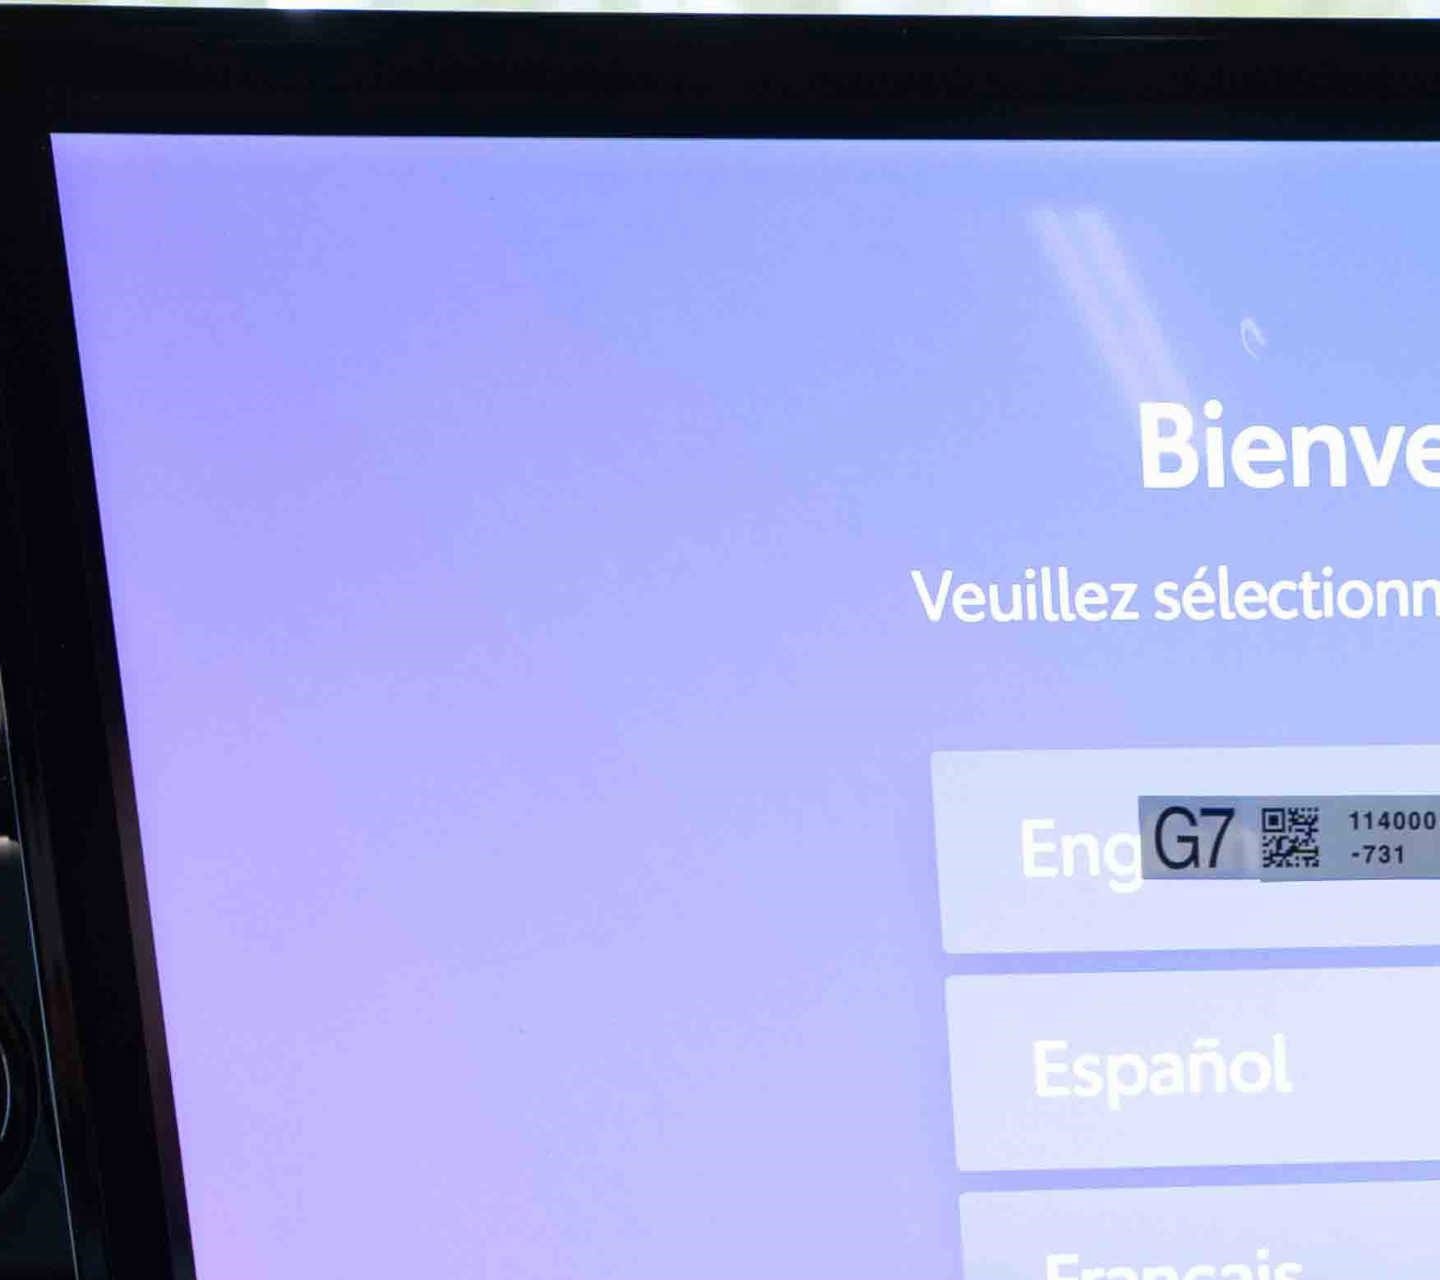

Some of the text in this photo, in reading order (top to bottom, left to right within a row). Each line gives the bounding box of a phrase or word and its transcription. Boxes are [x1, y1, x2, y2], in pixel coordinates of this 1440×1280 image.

[911, 567, 1137, 625] Veuillez
[1154, 806, 1235, 869] G7
[1349, 811, 1437, 831] 114000
[1351, 845, 1405, 864] -731
[1032, 1033, 1293, 1111] Español
